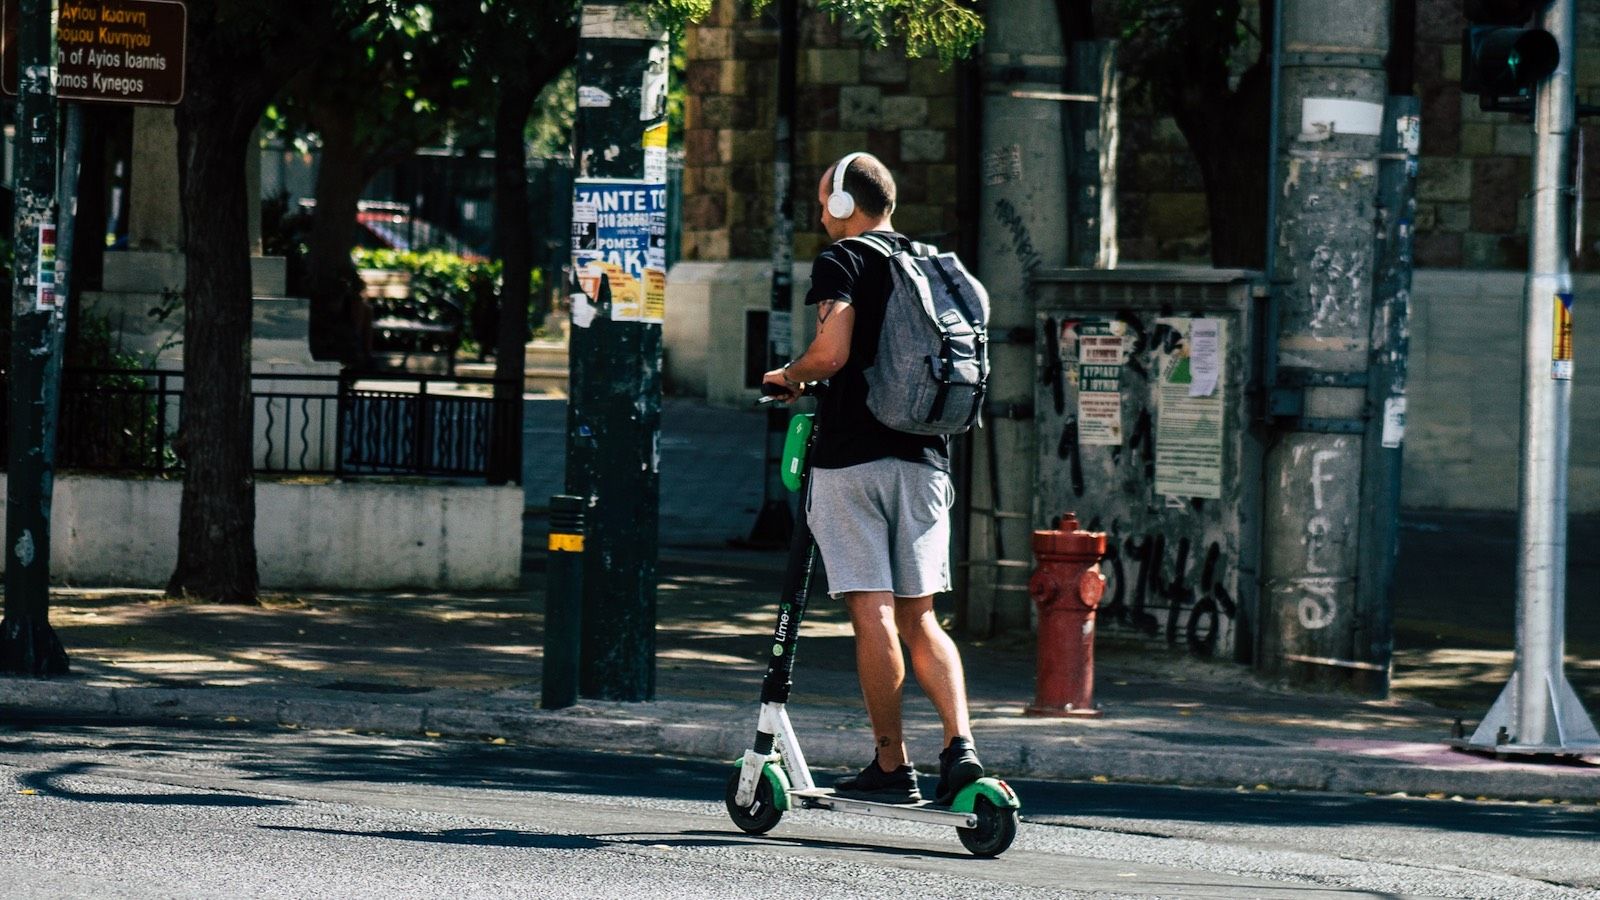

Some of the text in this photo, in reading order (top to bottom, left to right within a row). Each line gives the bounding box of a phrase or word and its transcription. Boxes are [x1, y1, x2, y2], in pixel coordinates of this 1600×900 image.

[70, 48, 83, 65] of
[87, 50, 121, 69] Ayios
[125, 52, 166, 71] Ioannis
[56, 73, 144, 95] omos Kynegos
[579, 190, 647, 212] ZANTE
[599, 237, 639, 250] ΡΟΜΕΣ
